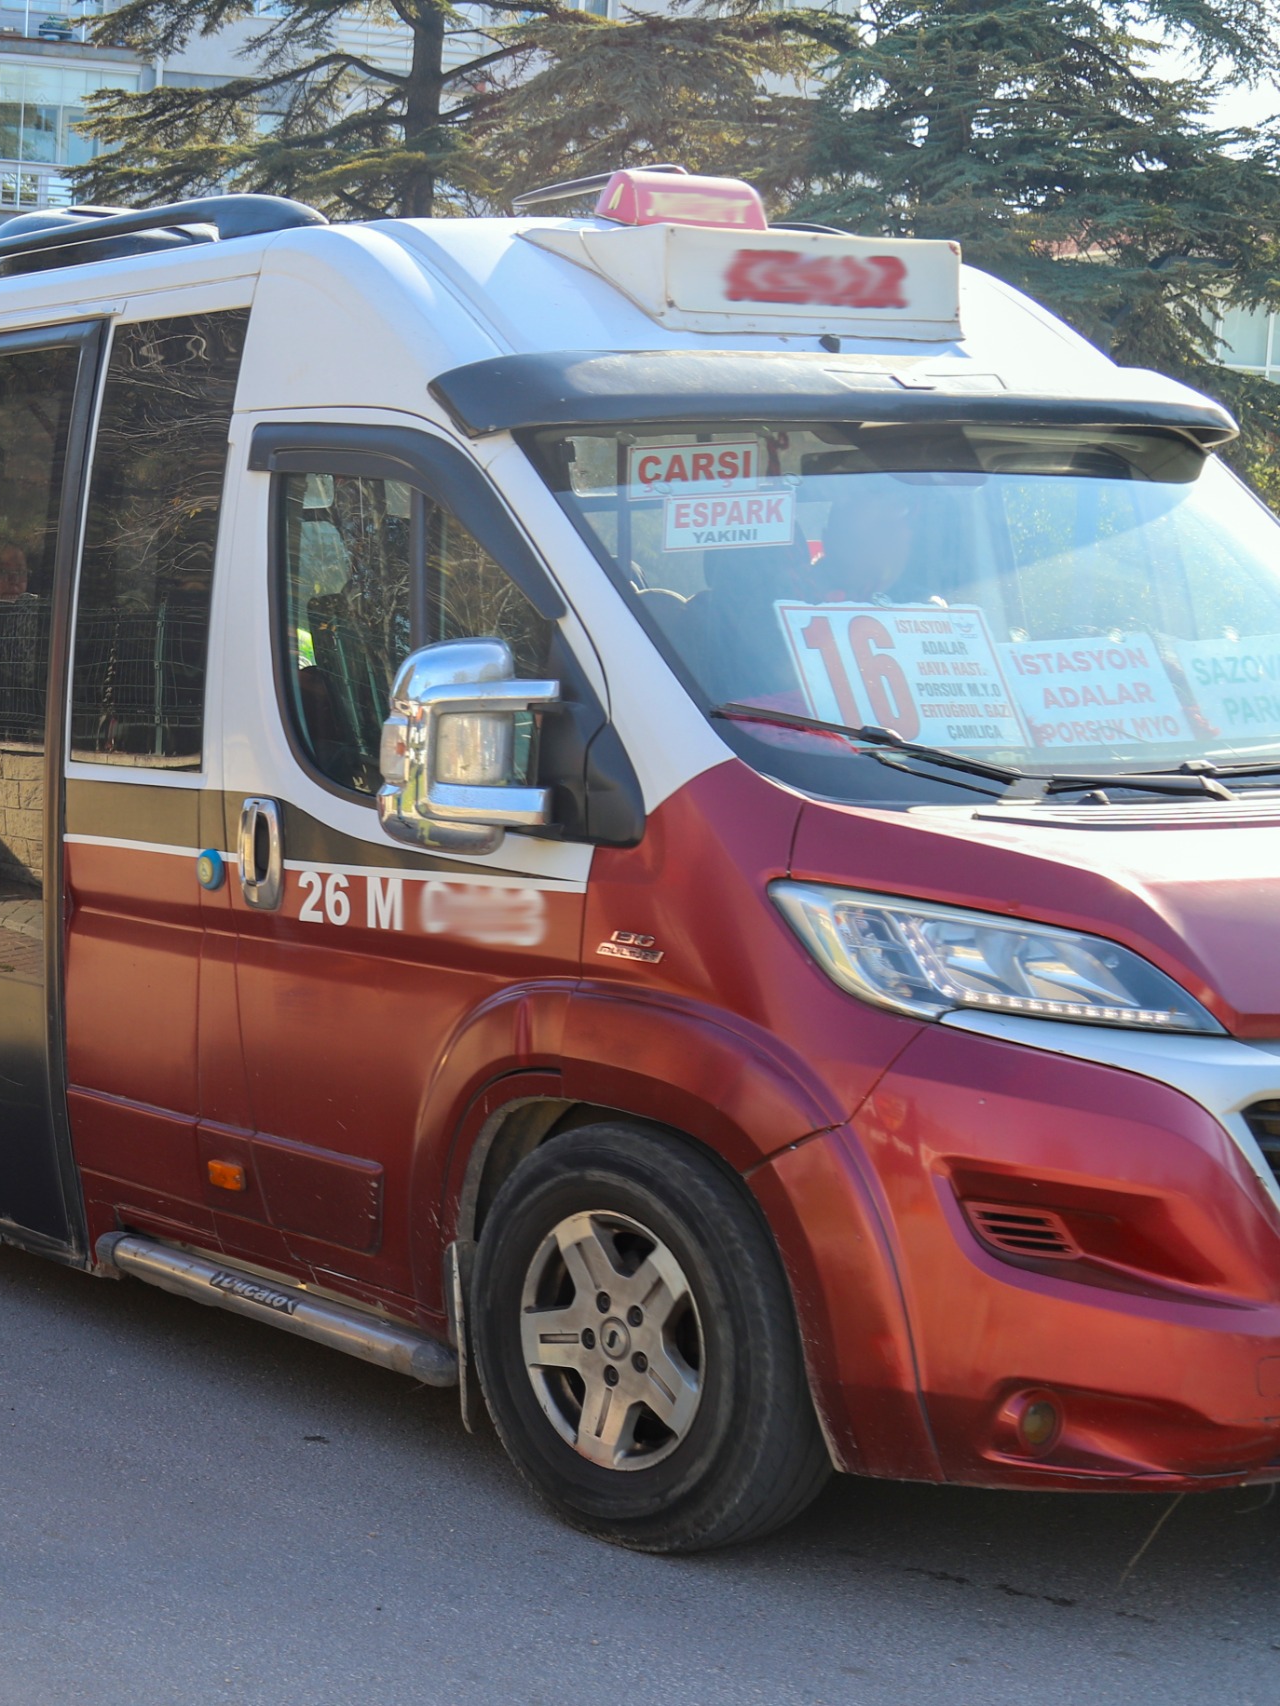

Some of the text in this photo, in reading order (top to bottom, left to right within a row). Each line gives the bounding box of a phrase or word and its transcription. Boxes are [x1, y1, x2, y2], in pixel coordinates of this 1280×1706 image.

[638, 451, 752, 493] ÇARŞI
[674, 498, 784, 529] ESPARK
[693, 528, 758, 544] YAKINI
[894, 617, 953, 634] İSTASYON
[922, 640, 969, 655] ADALAR
[1010, 647, 1150, 676] İSTASYON
[801, 614, 920, 743] 16
[916, 661, 950, 676] HAVA
[1191, 654, 1280, 686] SAZOV
[915, 682, 966, 697] PORSUK
[1042, 681, 1157, 710] ADALAR
[920, 700, 984, 718] ERTUĞRUL
[1044, 715, 1180, 744] PORSUK MYO
[298, 872, 351, 926] 26
[367, 876, 404, 931] M
